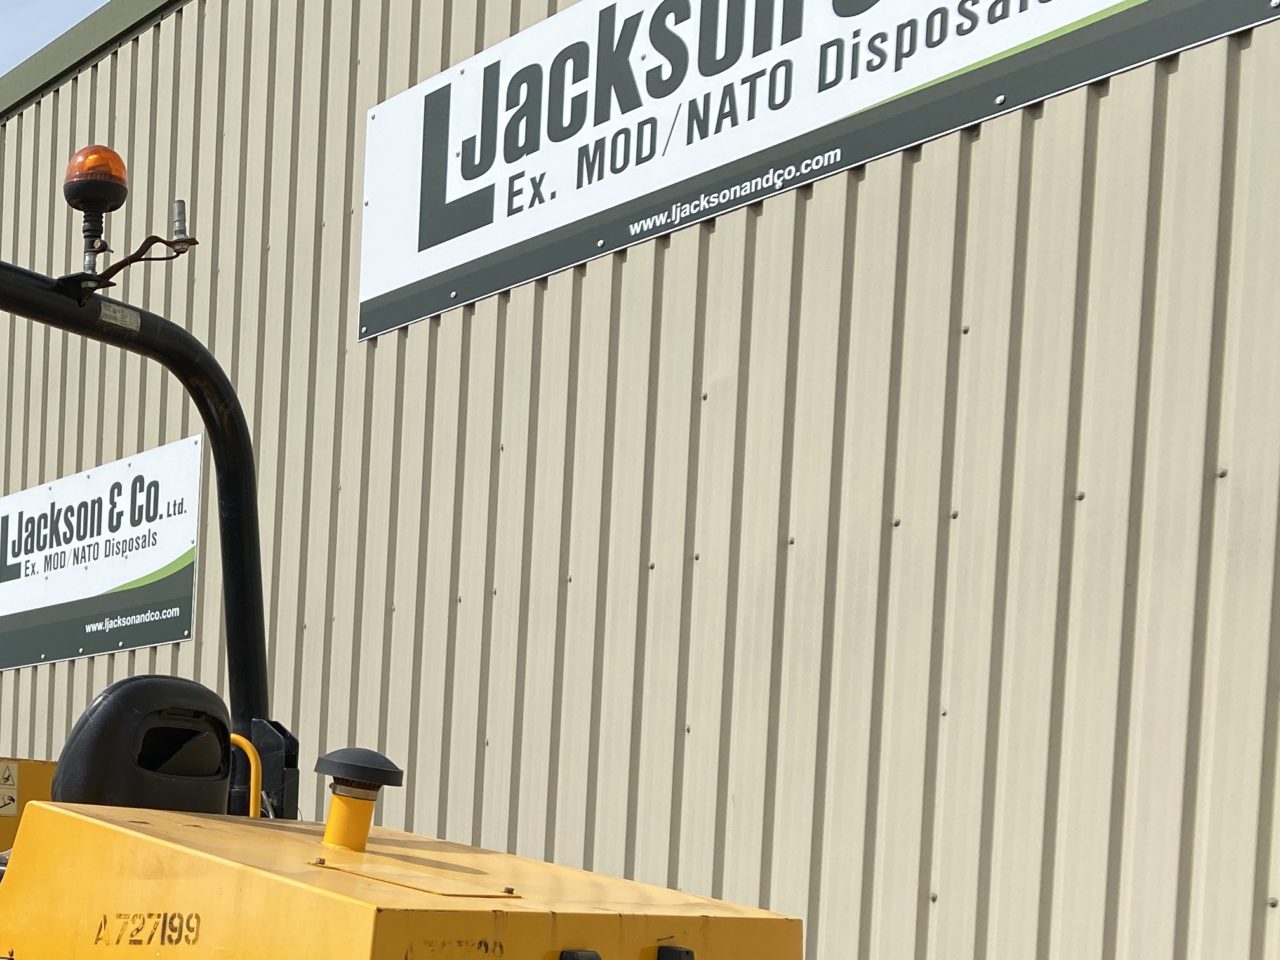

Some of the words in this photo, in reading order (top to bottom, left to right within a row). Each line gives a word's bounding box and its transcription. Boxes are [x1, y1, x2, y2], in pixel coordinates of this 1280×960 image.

[507, 171, 557, 218] Ex.
[576, 59, 793, 190] MOD/NATO
[818, 0, 1031, 93] Disposa
[629, 147, 841, 237] www.ljacksonandco.com
[108, 481, 124, 533] &
[130, 474, 163, 528] Co.
[166, 498, 187, 518] Ltd.
[24, 560, 39, 578] Ex.
[104, 529, 157, 558] Disposals
[85, 606, 180, 633] www.ljacksonandco.com
[94, 912, 201, 946] A727199
